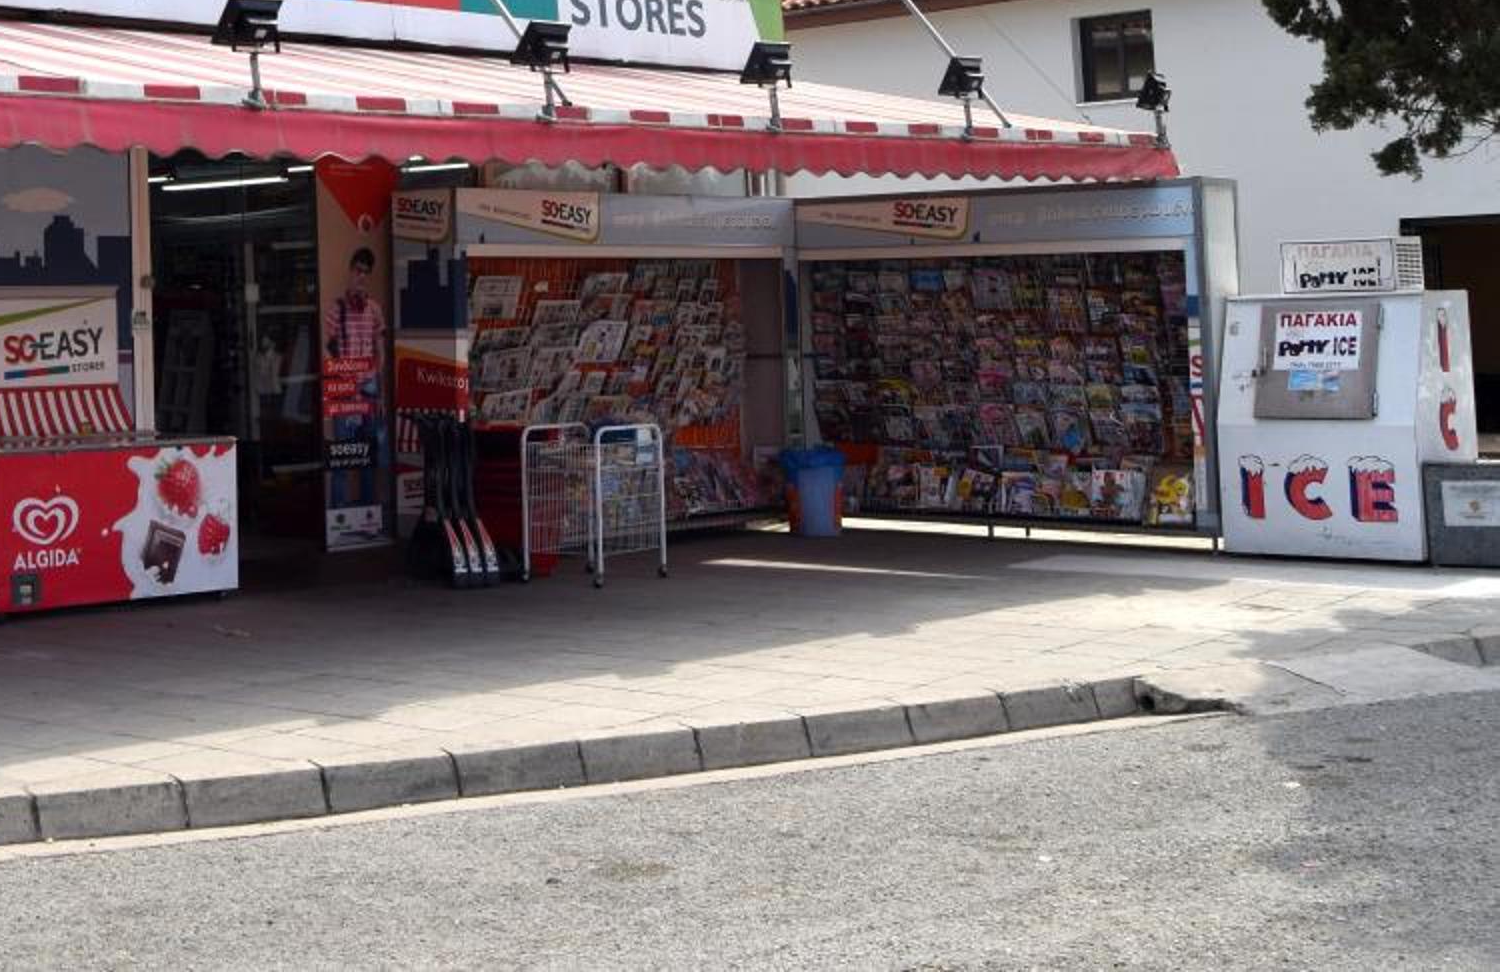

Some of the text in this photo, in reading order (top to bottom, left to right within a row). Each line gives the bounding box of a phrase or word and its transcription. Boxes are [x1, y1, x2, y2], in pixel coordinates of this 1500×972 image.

[1280, 313, 1357, 327] ΠΑΓΑΚΙΑ
[1333, 336, 1357, 356] ICE
[1436, 307, 1460, 451] IC
[1238, 454, 1399, 523] ICE
[13, 549, 79, 572] ALGIDA
